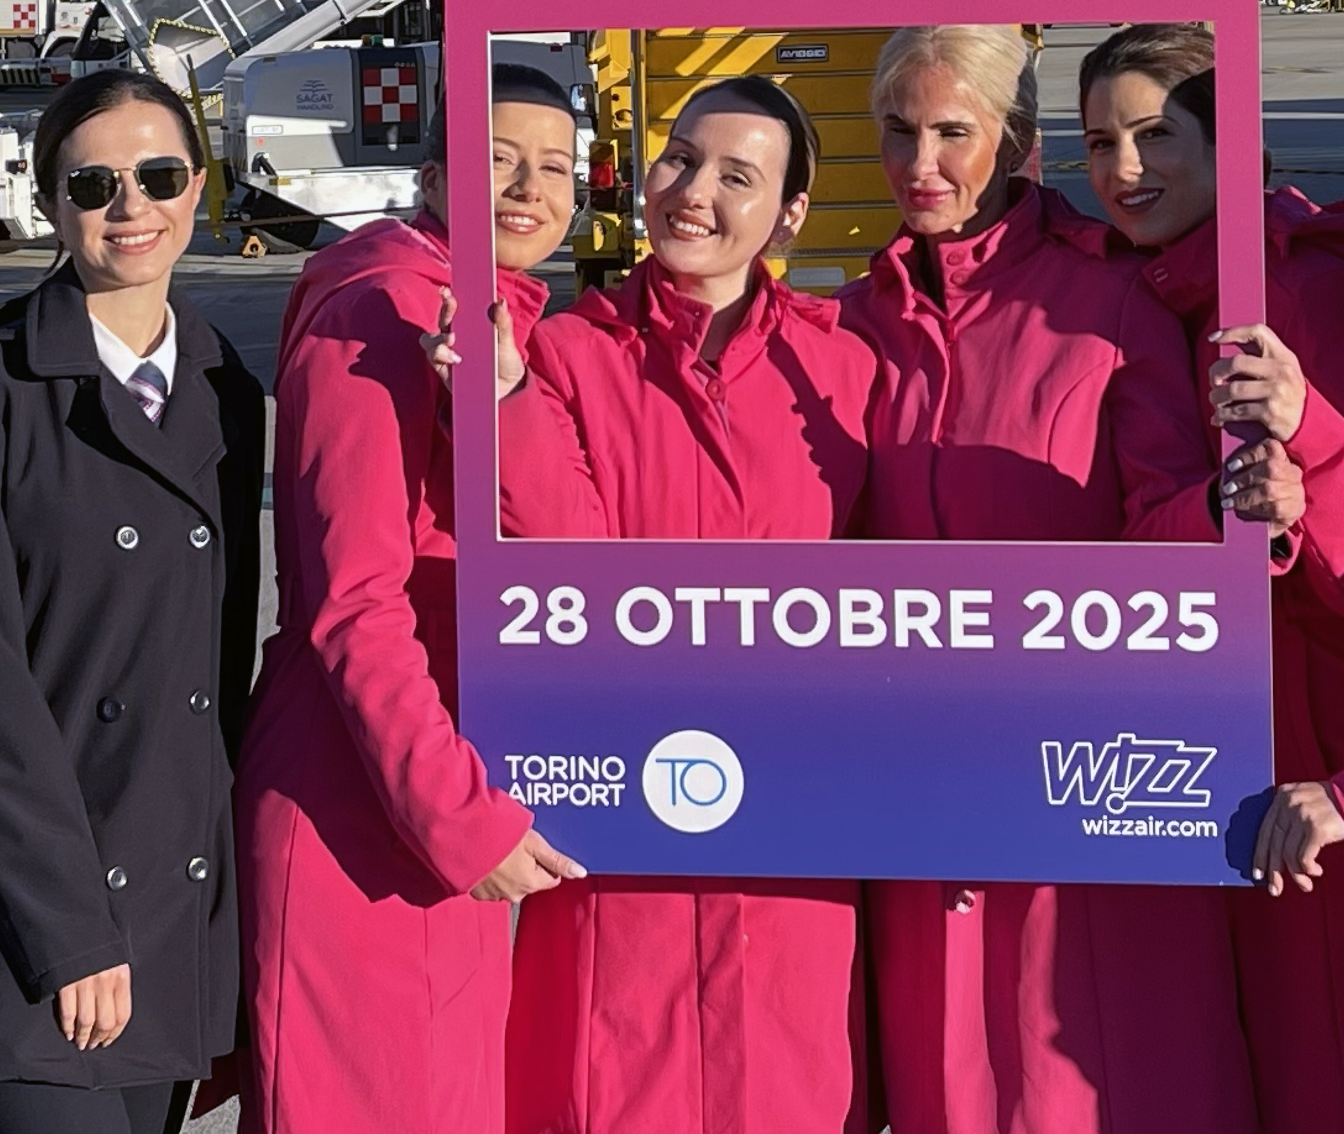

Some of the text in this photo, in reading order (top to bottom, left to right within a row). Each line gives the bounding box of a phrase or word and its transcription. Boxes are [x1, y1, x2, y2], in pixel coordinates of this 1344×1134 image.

[296, 93, 333, 104] SAGAT
[499, 585, 1220, 653] 28 OTTOBRE 2025
[504, 754, 626, 782] TORINO
[508, 781, 626, 807] AIRPORT
[655, 758, 728, 807] TO
[1081, 815, 1218, 838] wizzair.com
